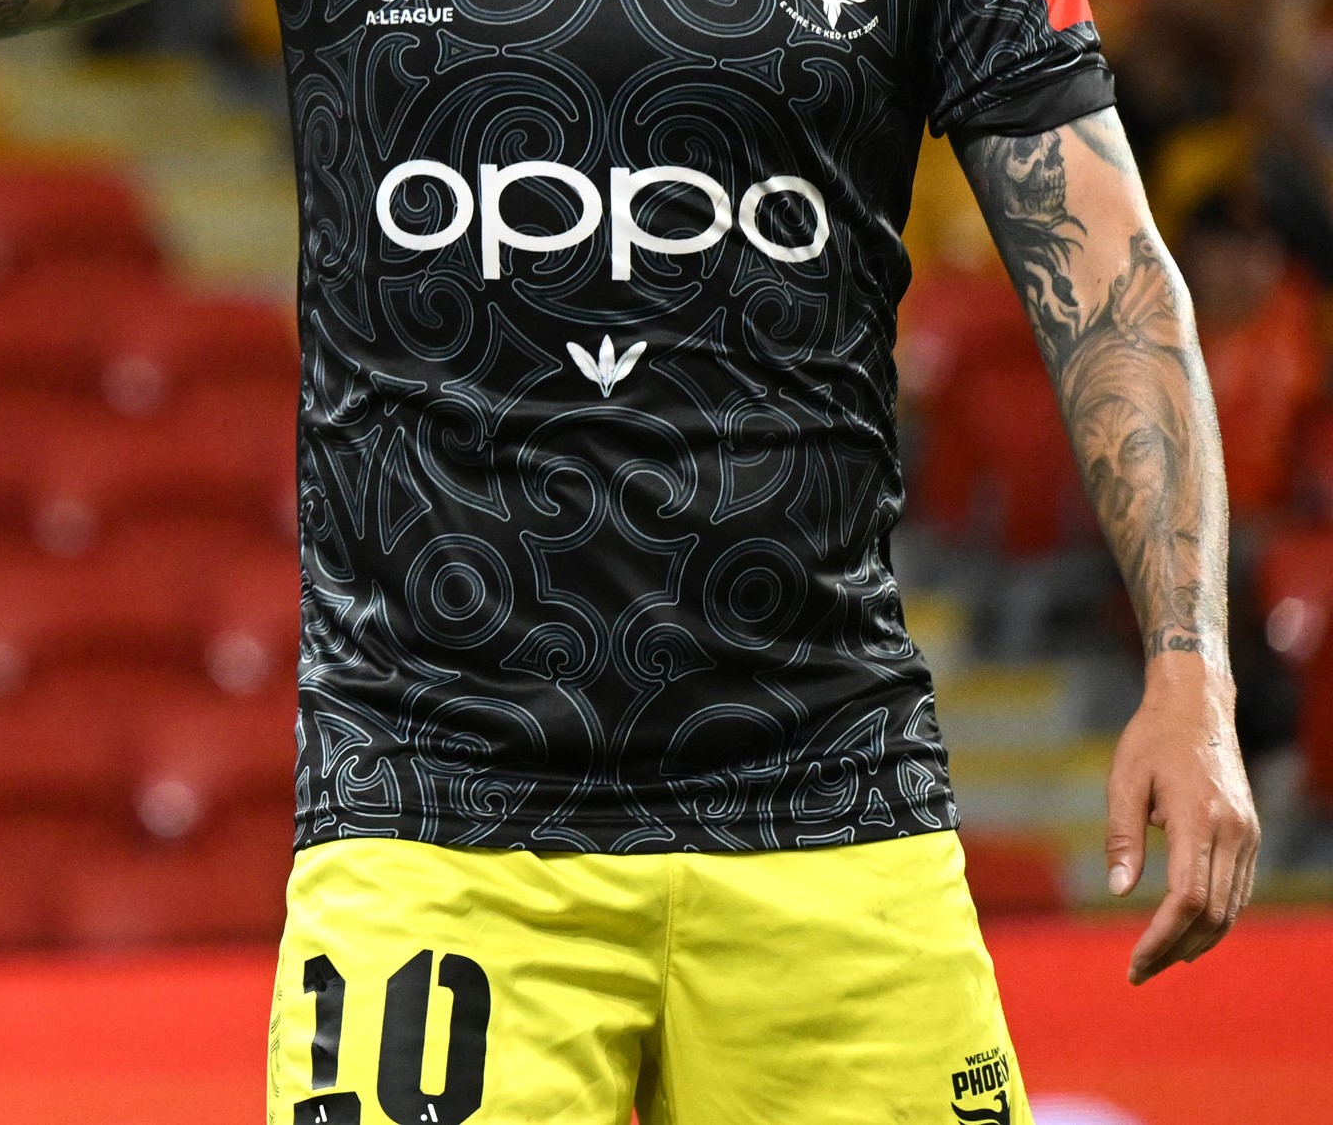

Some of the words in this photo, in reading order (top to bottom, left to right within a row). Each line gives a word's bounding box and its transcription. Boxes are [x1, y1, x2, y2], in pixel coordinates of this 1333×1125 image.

[366, 7, 453, 26] A-LEAGUE
[376, 159, 830, 280] oppo
[293, 949, 492, 1125] 10
